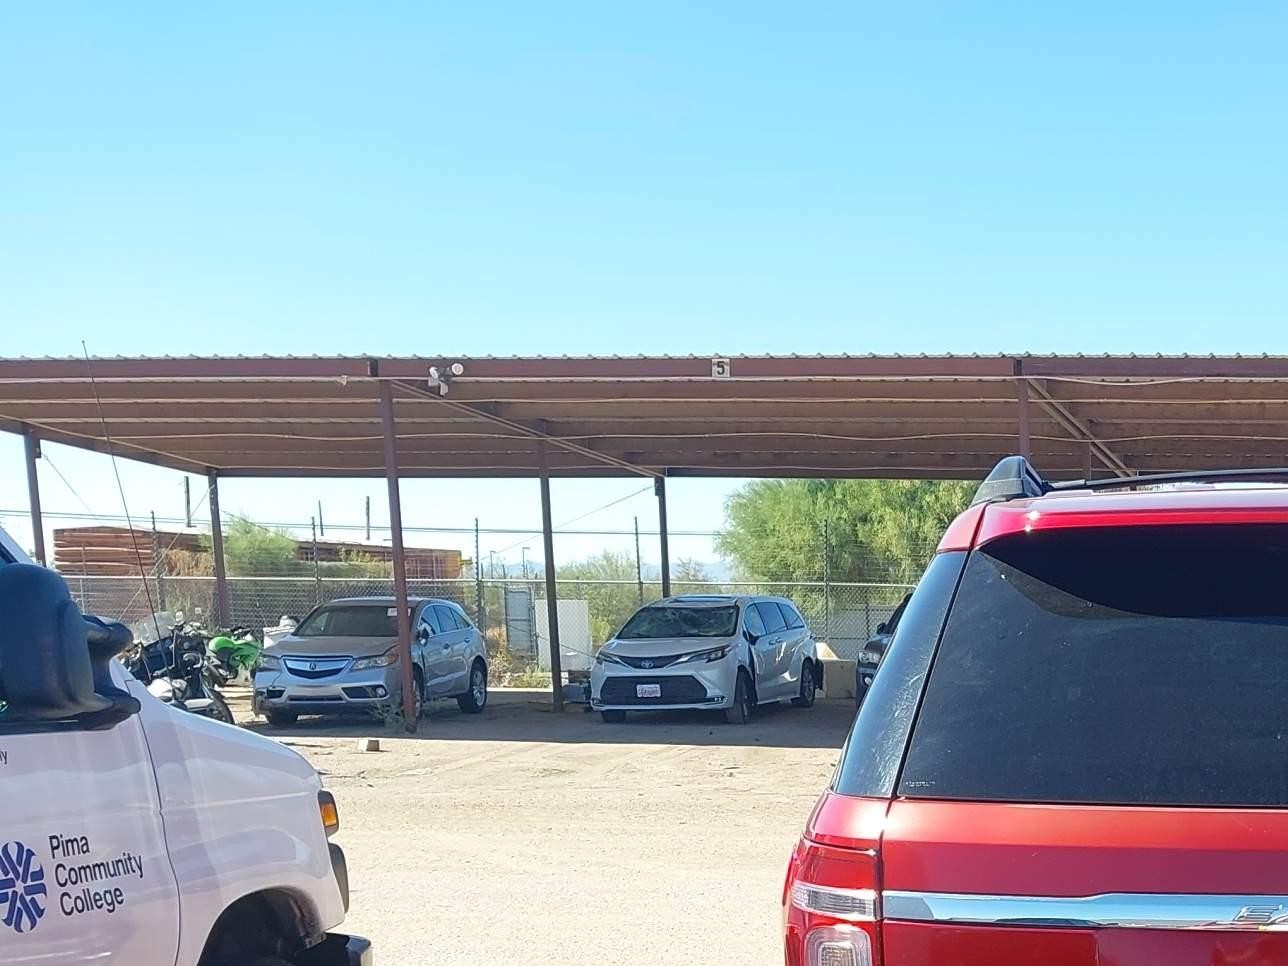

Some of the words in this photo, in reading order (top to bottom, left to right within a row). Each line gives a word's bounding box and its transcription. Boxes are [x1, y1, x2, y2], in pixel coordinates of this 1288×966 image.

[716, 360, 726, 376] 5
[48, 833, 91, 859] Pima
[54, 852, 144, 888] Community
[60, 886, 125, 916] College
